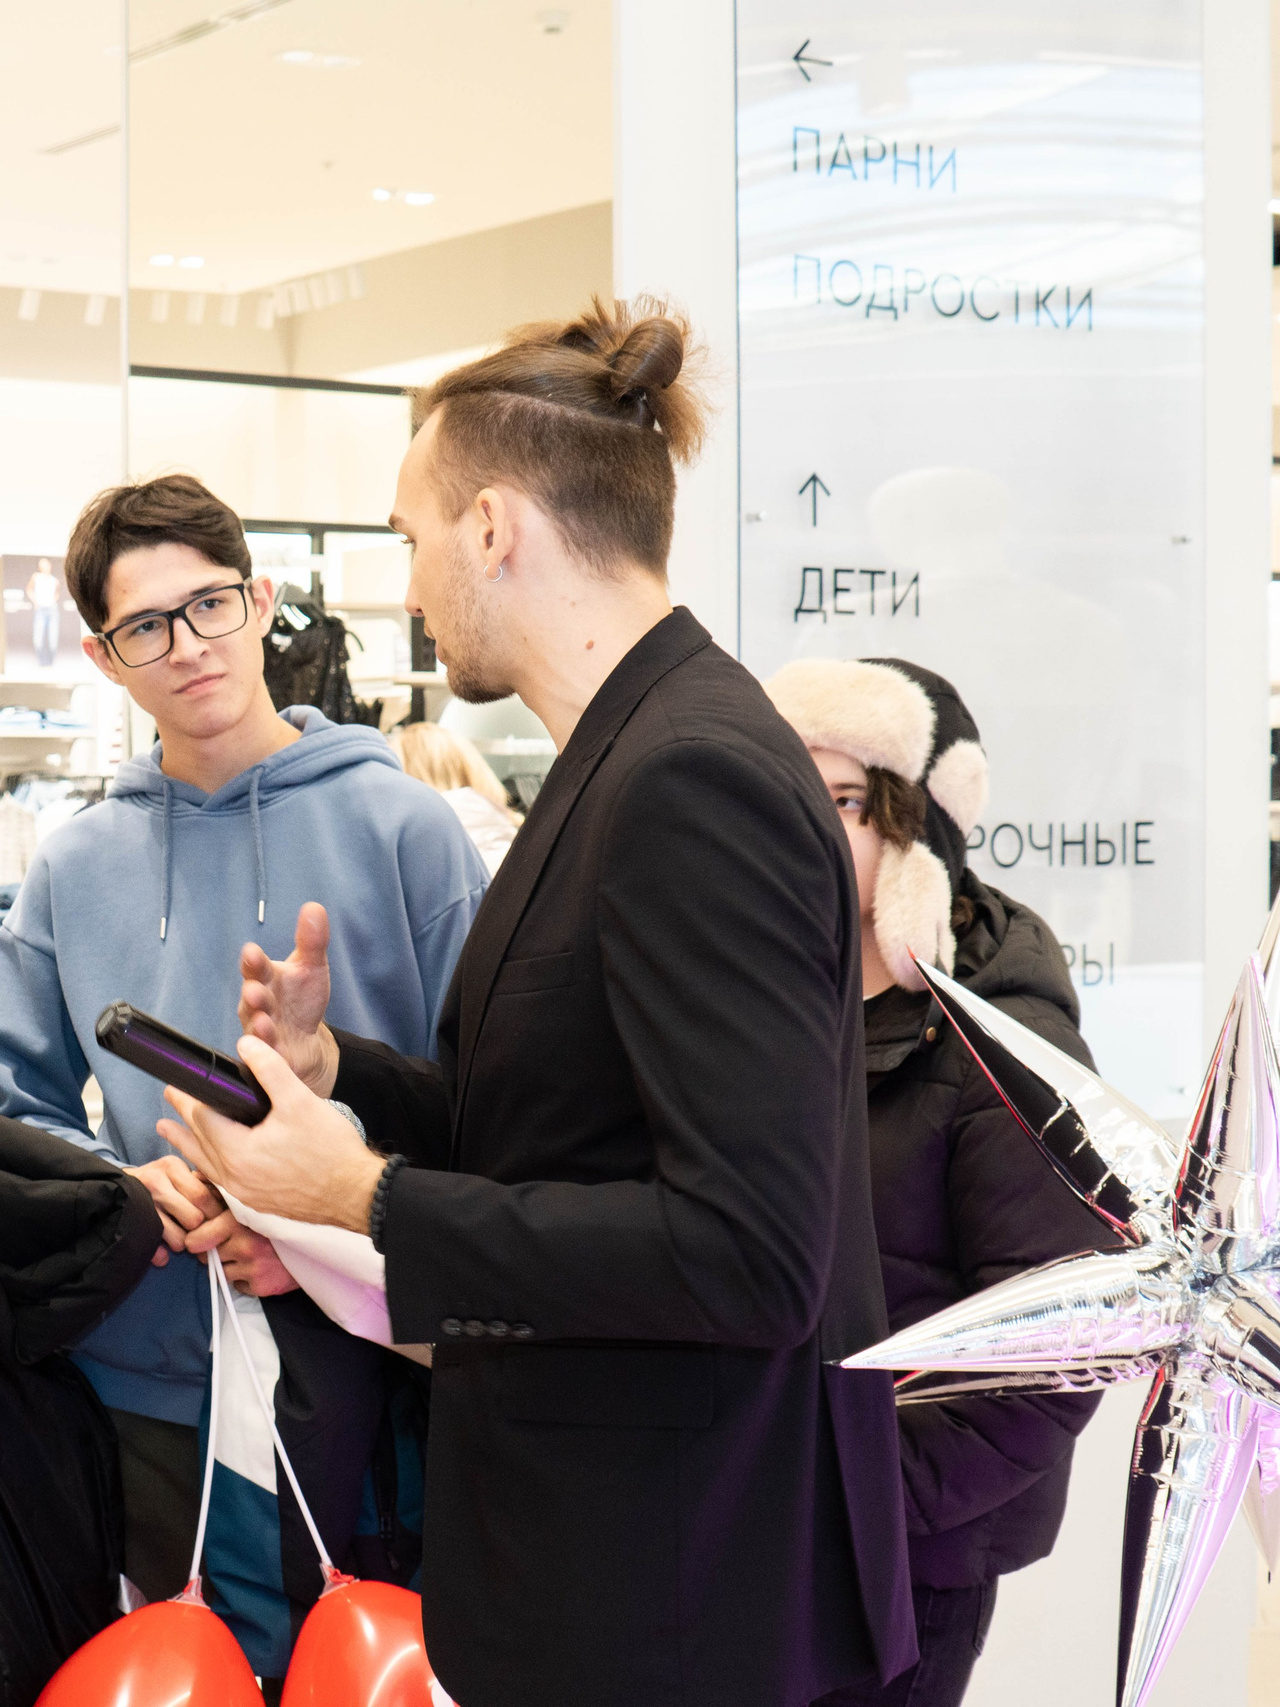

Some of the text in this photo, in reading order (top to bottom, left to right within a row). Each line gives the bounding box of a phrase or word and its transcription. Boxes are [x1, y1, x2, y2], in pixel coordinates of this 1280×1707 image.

[792, 125, 958, 193] ПАРНИ
[792, 253, 1094, 332] ПОДРОСТКИ
[794, 566, 921, 624] ДЕТИ
